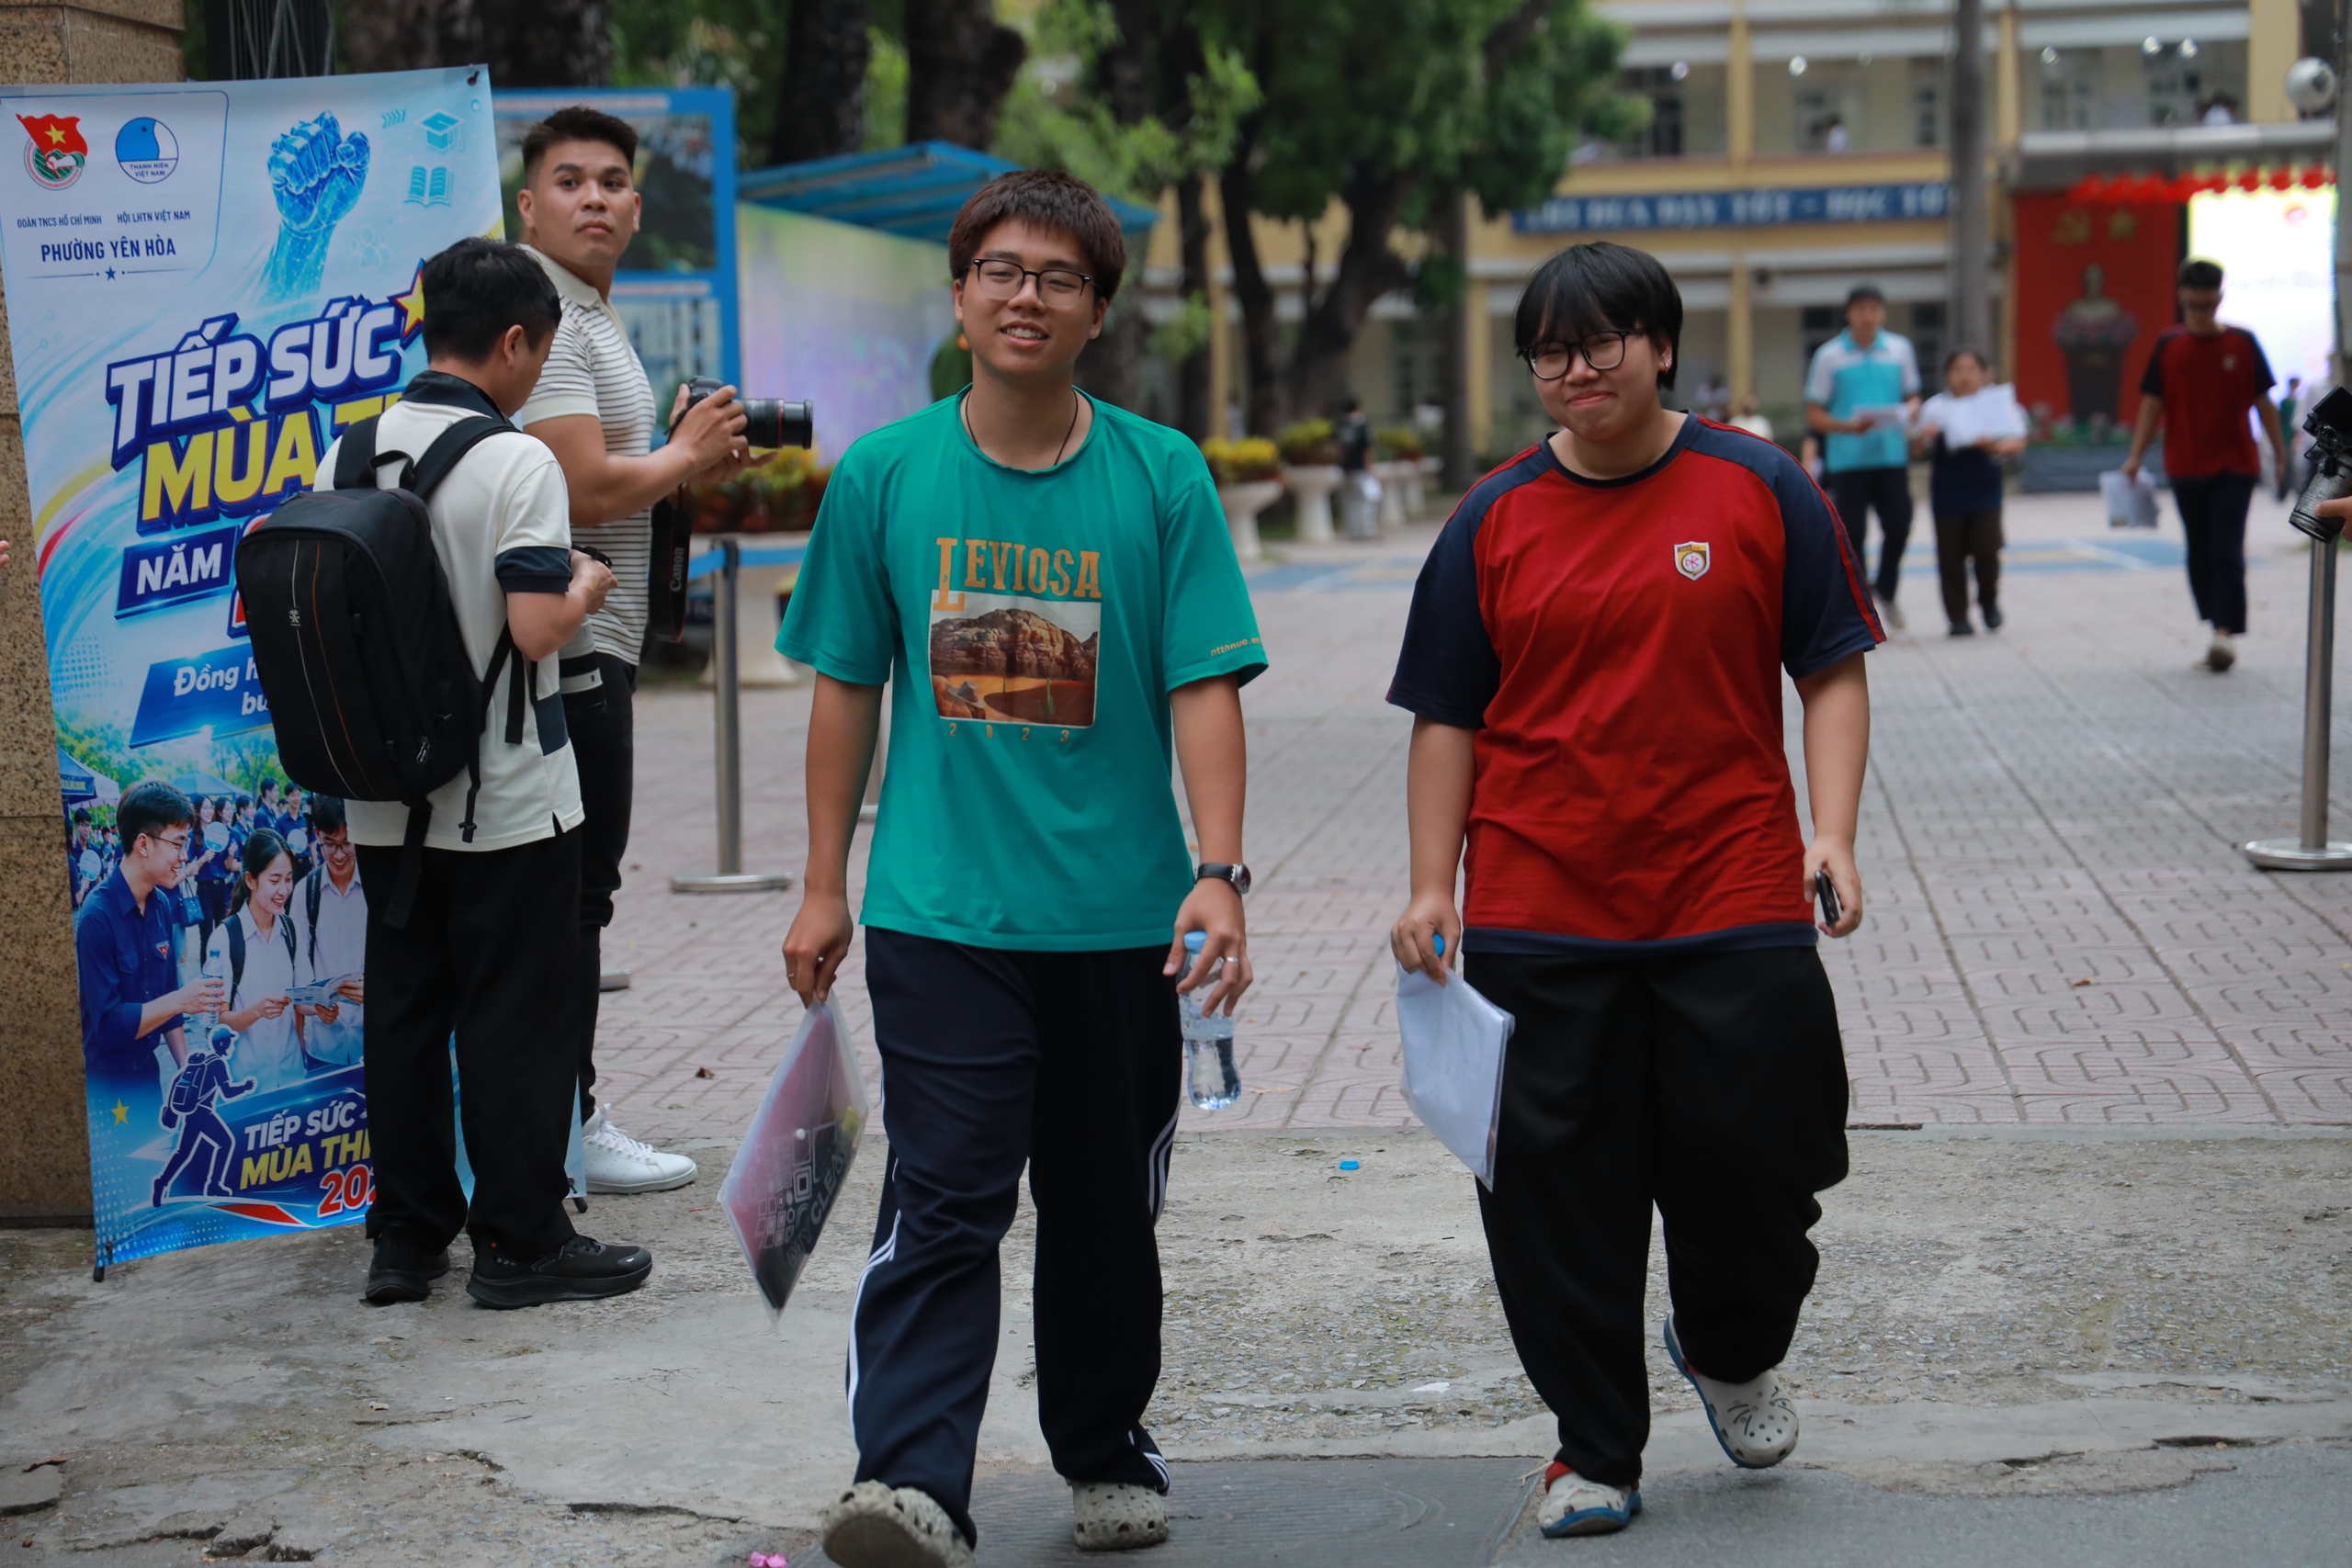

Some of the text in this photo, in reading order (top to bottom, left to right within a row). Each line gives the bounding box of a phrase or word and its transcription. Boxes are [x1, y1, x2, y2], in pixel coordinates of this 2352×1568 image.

[17, 215, 37, 228] ĐOÀN
[39, 217, 57, 227] TNCS
[70, 213, 82, 225] CHÍ
[84, 214, 102, 225] MINH
[117, 209, 190, 224] HỘI LHTN VIỆT NAM
[41, 234, 176, 263] PHƯỜNG YÊN HÒA
[107, 296, 398, 465] TIẾP SỨC
[138, 402, 323, 529] MÙA
[136, 543, 222, 595] NĂM
[670, 547, 684, 592] Canon
[933, 536, 1102, 612] LEVIOSA
[174, 664, 239, 697] Đồng
[244, 1100, 357, 1151] TIẾP SỨC
[240, 1128, 370, 1190] MÙA THI
[317, 1164, 377, 1218] 20
